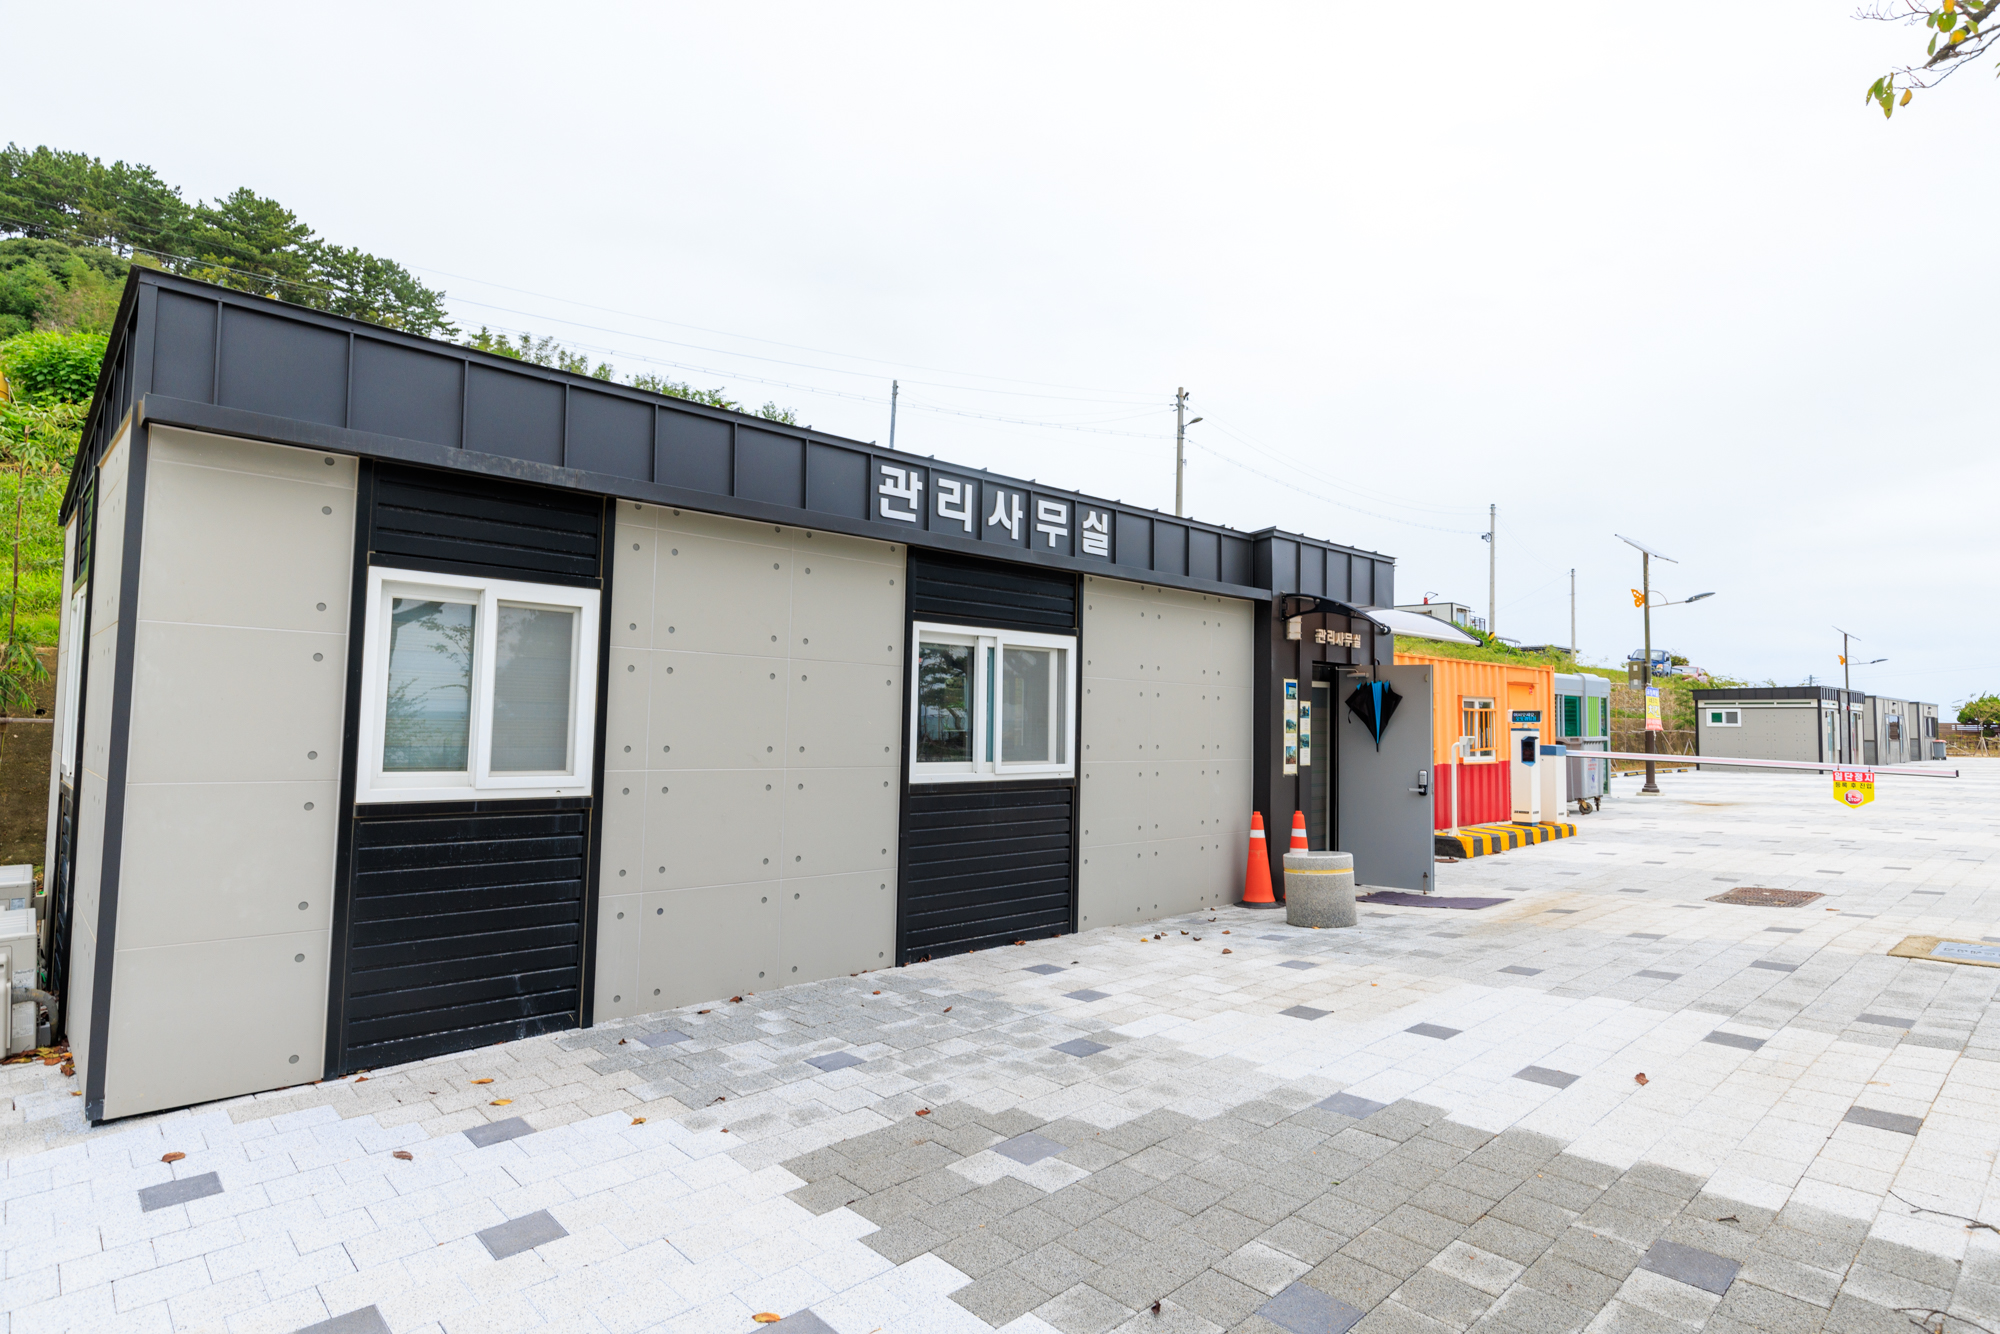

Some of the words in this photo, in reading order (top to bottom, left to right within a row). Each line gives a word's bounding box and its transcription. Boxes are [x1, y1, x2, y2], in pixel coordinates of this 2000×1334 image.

[878, 464, 1109, 557] 관리사무실
[1315, 628, 1361, 649] 관리사무실
[1834, 772, 1873, 782] 일단정지
